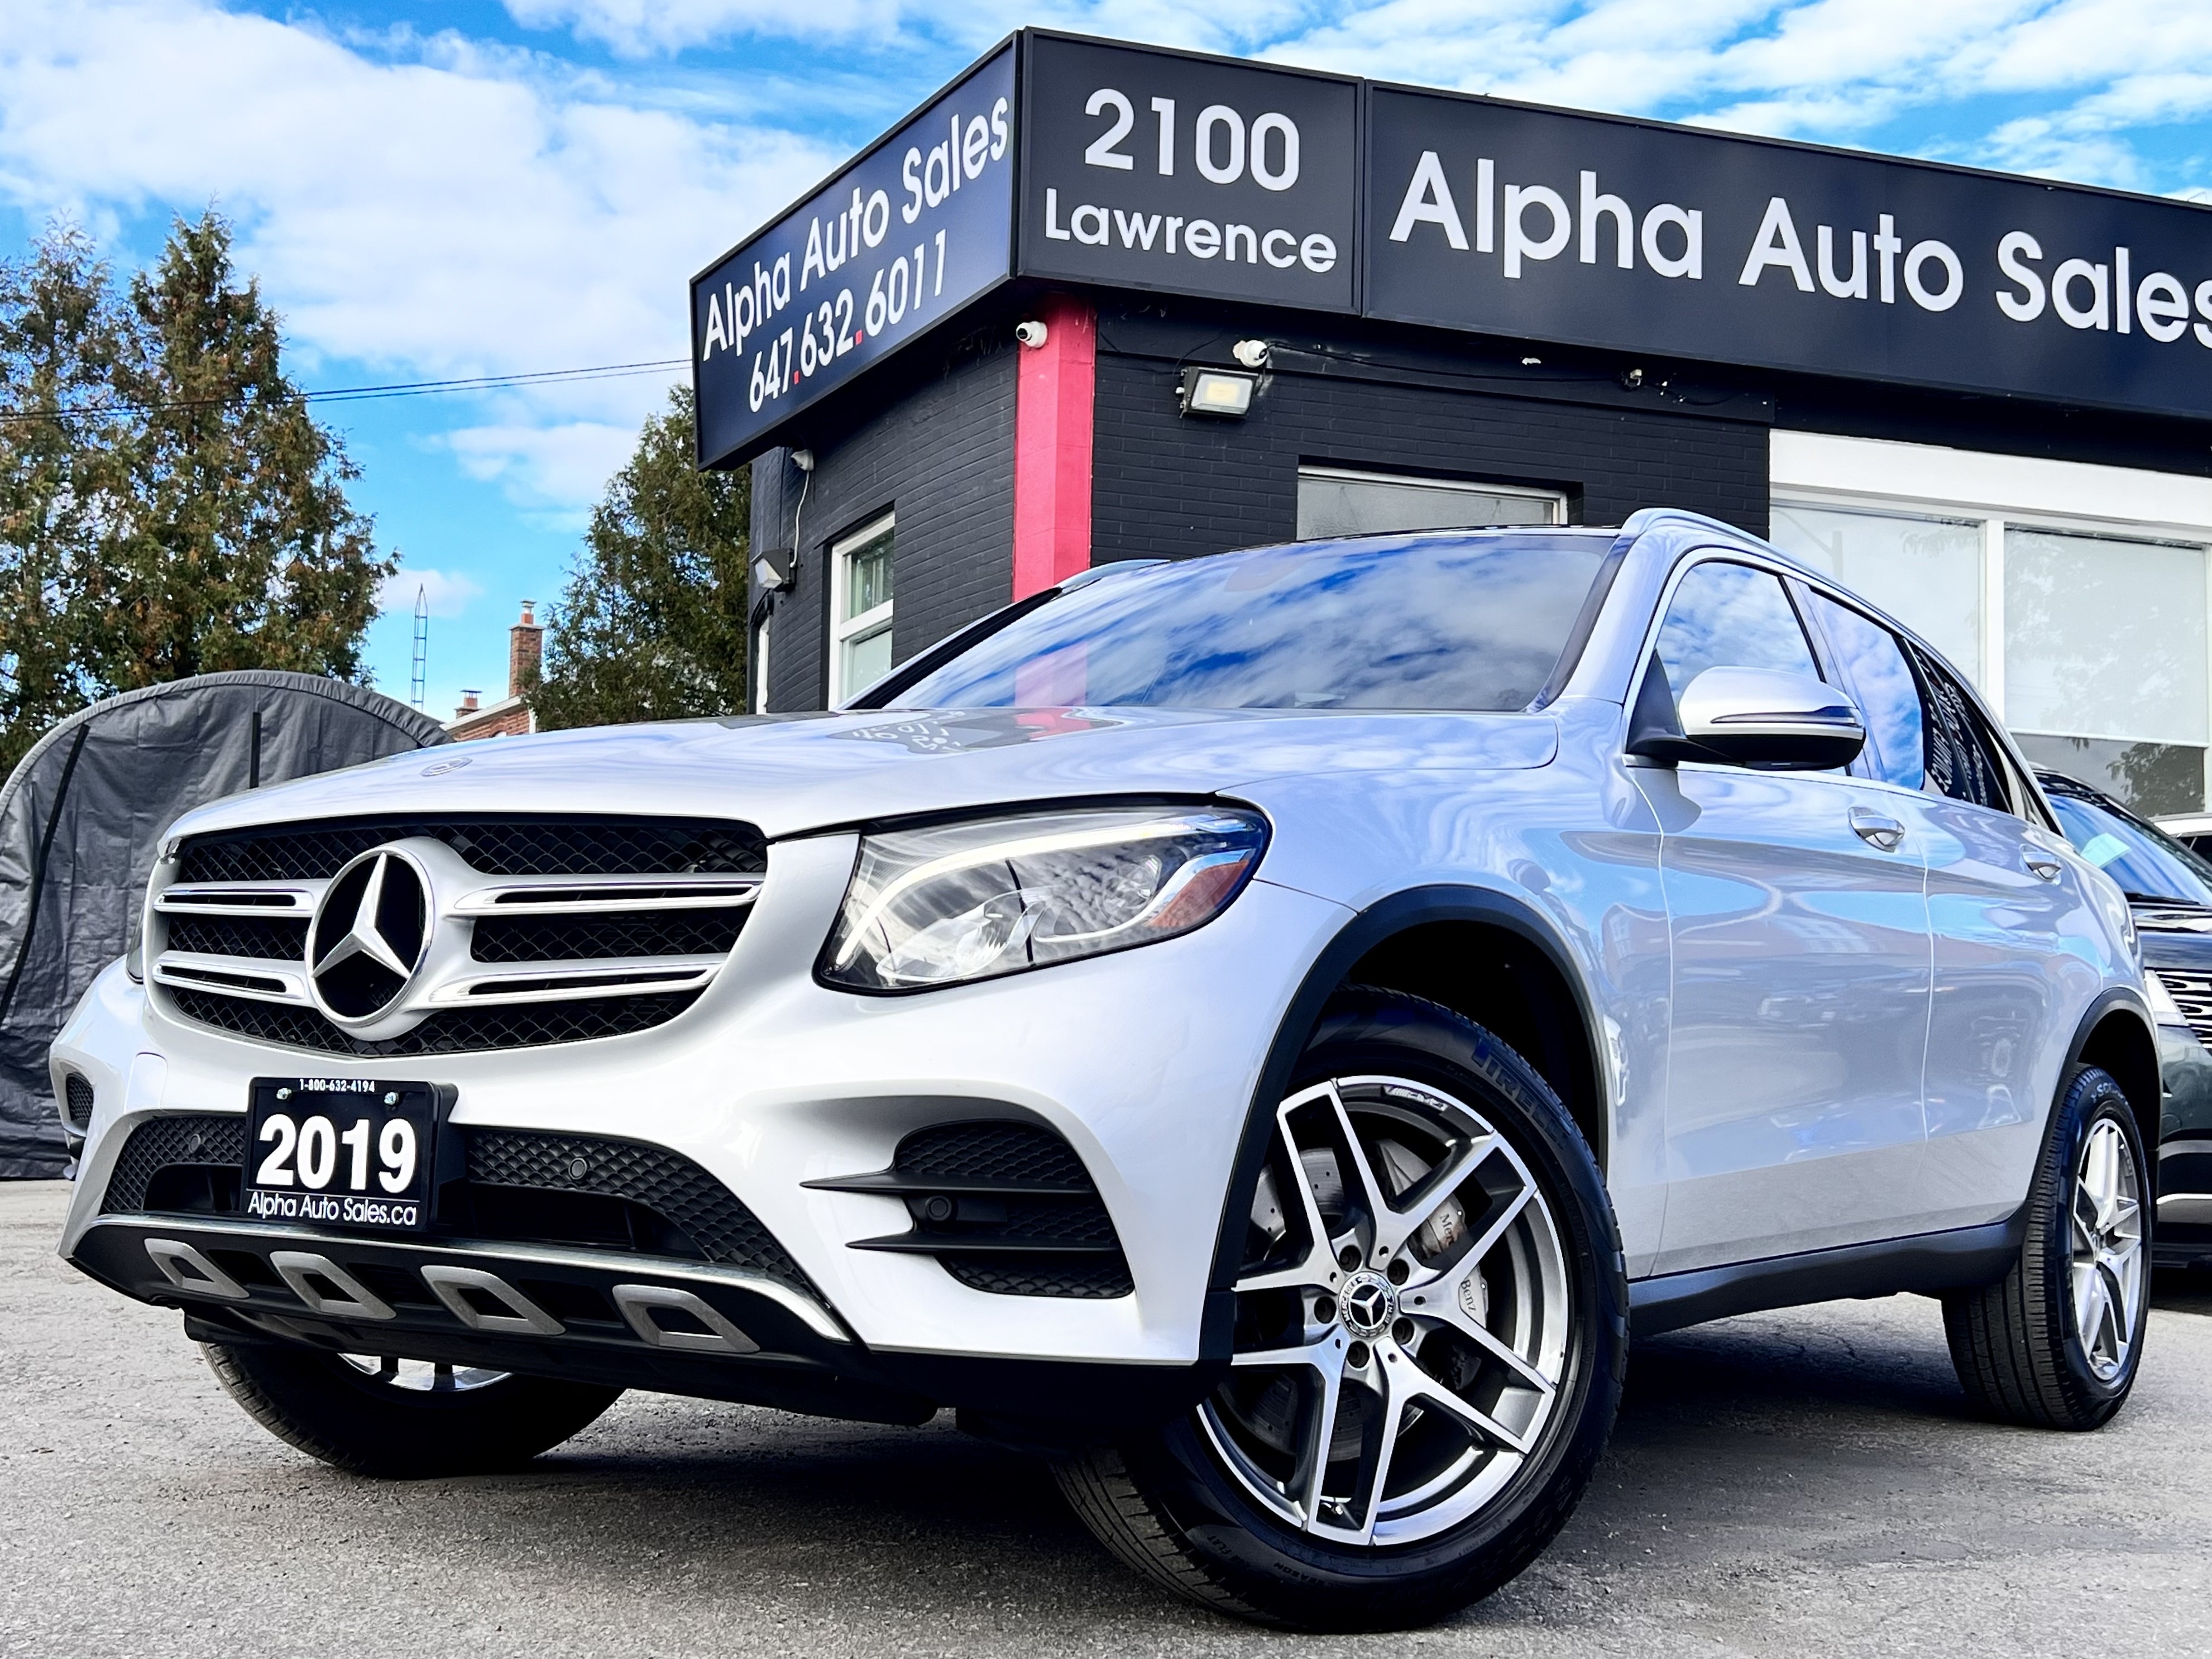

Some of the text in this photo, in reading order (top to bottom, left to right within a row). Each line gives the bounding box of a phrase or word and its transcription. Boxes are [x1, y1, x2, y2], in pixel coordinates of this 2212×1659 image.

[1085, 88, 1300, 191] 2100
[703, 97, 1008, 361] Alpha Auto Sales
[1046, 188, 1337, 272] Lawrence
[1389, 151, 1642, 280] Alpha
[1738, 197, 1964, 312] Auto
[749, 229, 947, 413] 647.632.6011
[299, 1078, 375, 1093] 1-800-632-4194
[256, 1114, 416, 1193] 2019
[247, 1191, 417, 1226] Alpha Auto Sales.ca
[1460, 1279, 1477, 1311] Benz
